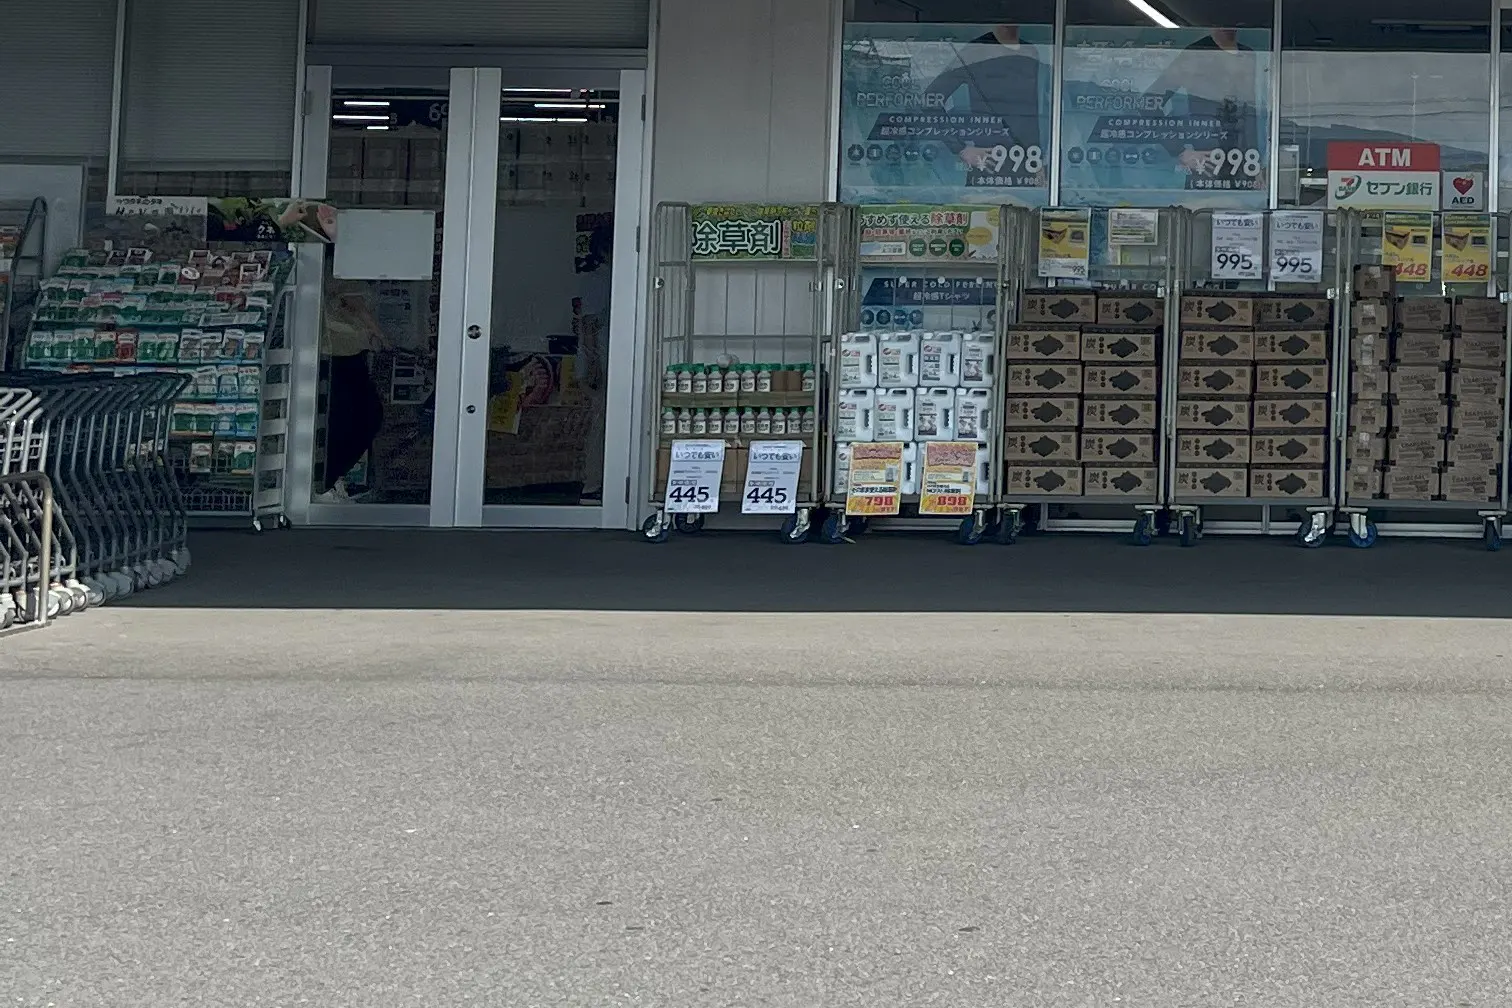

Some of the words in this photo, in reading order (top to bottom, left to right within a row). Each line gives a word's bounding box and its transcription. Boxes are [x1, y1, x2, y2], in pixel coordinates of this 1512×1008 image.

[857, 93, 945, 107] PERFORMER
[1076, 95, 1164, 110] PERFORMER
[970, 116, 1003, 124] INNER
[1358, 148, 1411, 167] ATM
[1367, 180, 1433, 196] セブン銀行
[1451, 196, 1475, 204] AED
[1216, 218, 1259, 227] いつでも安い
[1276, 222, 1319, 231] いつでも安い
[1217, 253, 1253, 270] 995
[1276, 256, 1312, 273] 995
[1451, 263, 1488, 277] 448
[675, 451, 719, 460] いつでも安い
[753, 452, 798, 461] いつでも安い
[669, 486, 710, 503] 445
[747, 487, 787, 504] 445
[865, 496, 894, 506] 798
[937, 496, 968, 506] 898
